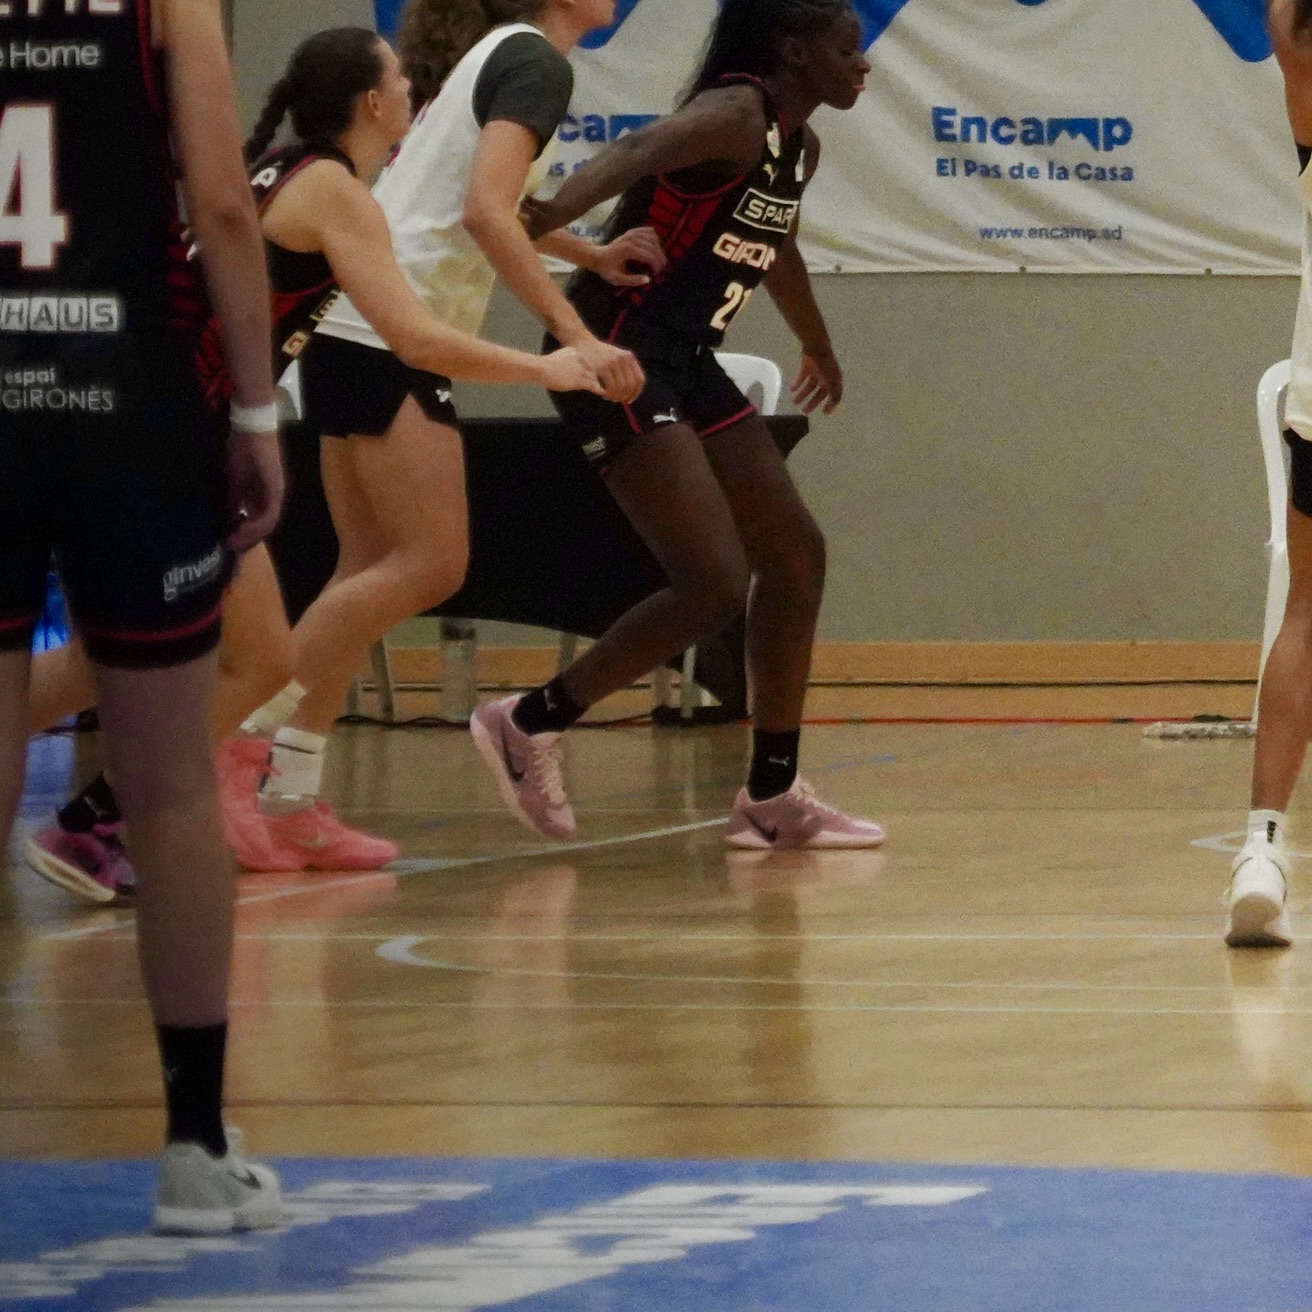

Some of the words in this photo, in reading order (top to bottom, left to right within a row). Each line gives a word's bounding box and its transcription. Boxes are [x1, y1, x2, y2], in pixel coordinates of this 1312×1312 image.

[10, 41, 100, 69] Home
[931, 106, 1134, 151] Encamp
[936, 158, 957, 177] El
[964, 159, 1002, 179] Pas
[1008, 162, 1040, 180] de
[1049, 161, 1070, 180] la
[1074, 162, 1135, 182] Casa
[979, 225, 1124, 242] www.encamp.ad
